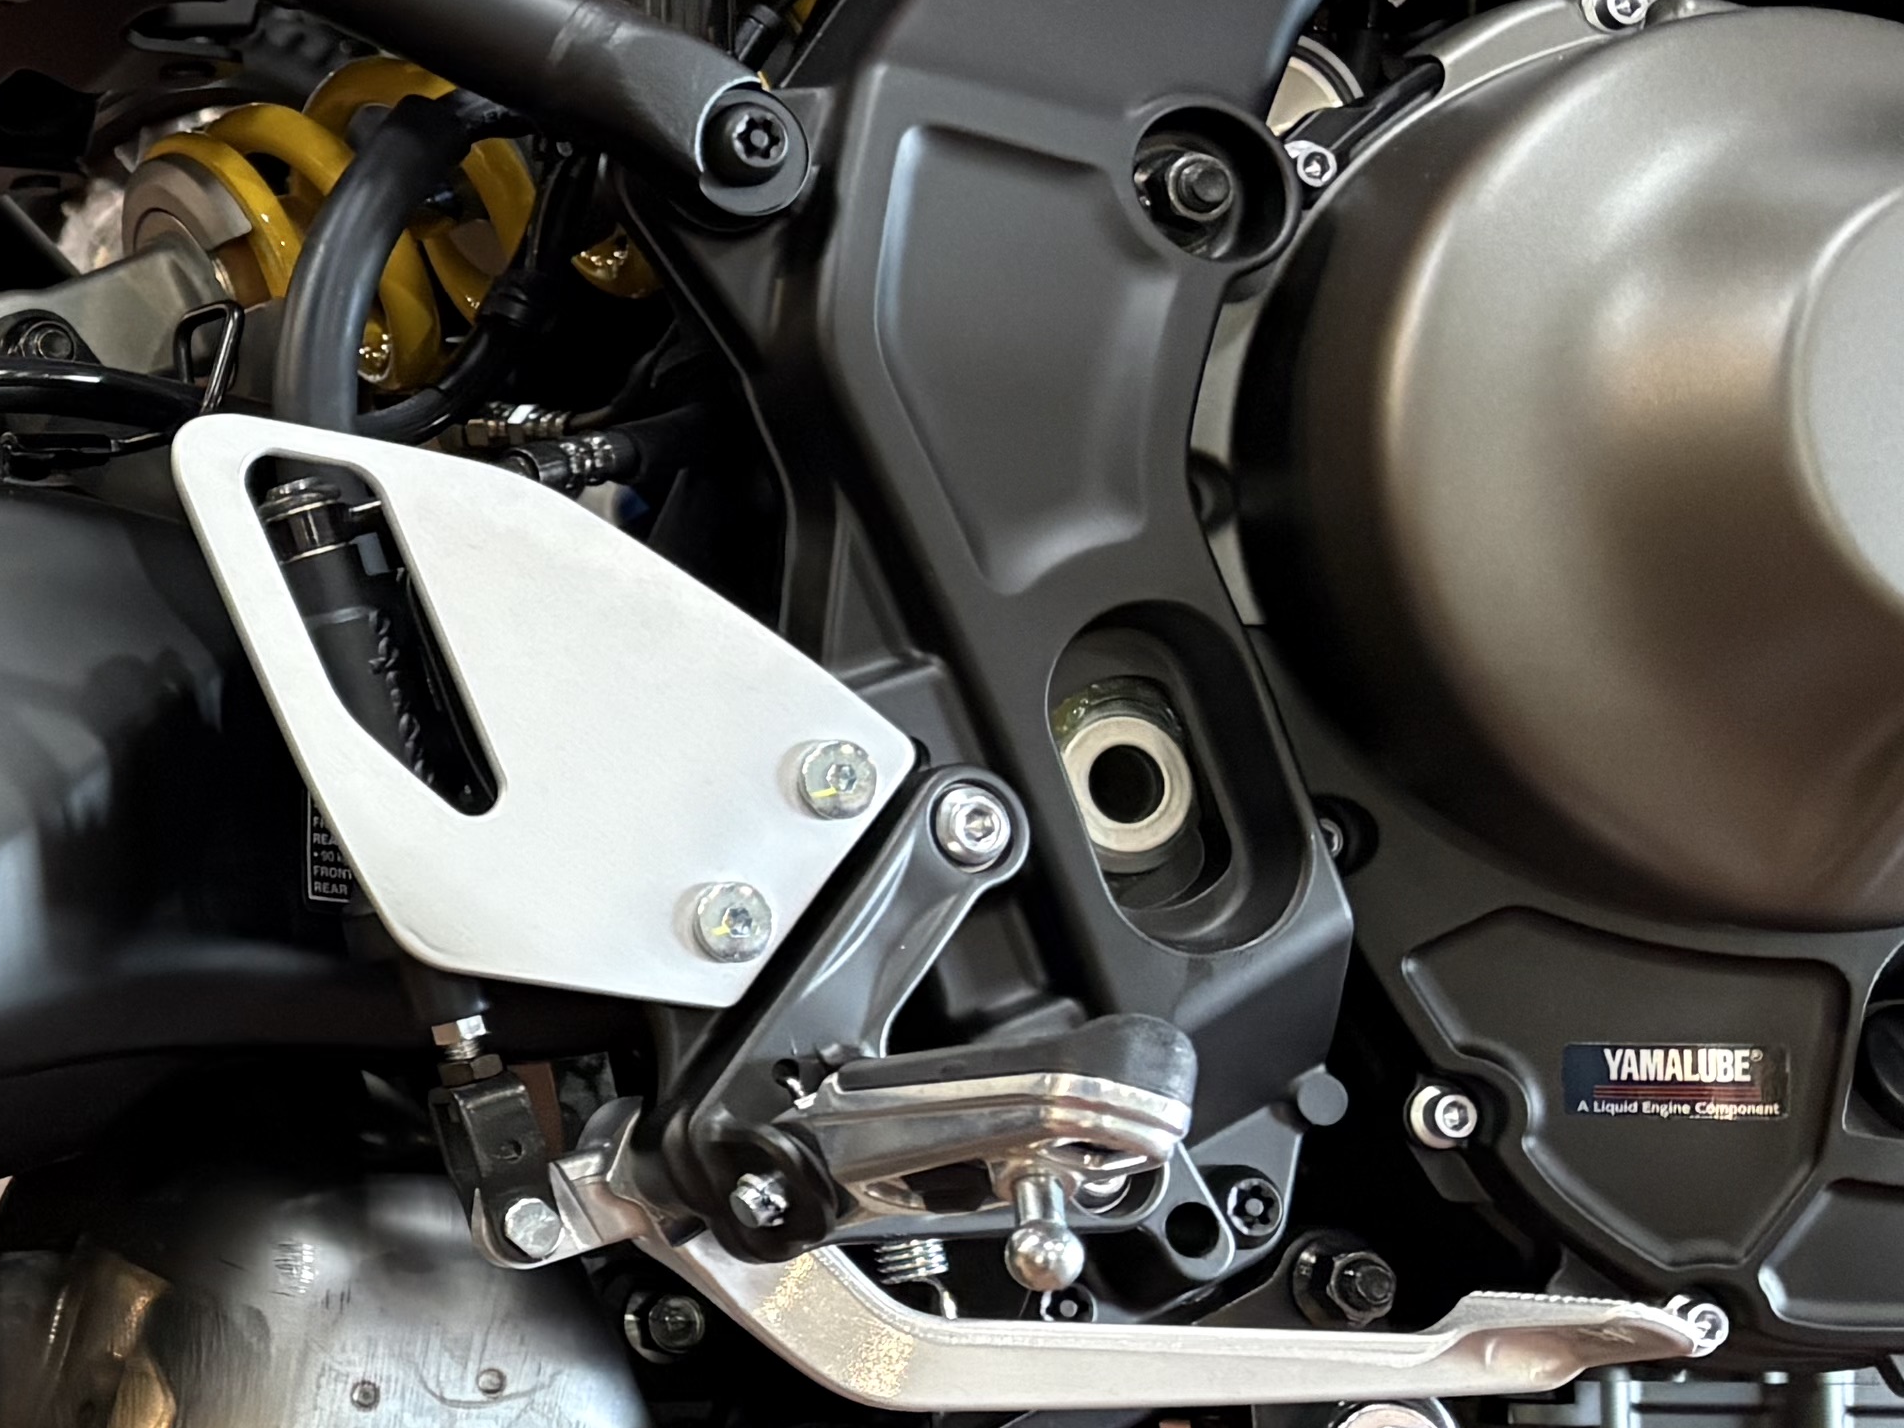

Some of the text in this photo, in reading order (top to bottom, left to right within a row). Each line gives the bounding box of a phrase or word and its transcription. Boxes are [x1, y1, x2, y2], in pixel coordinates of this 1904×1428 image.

[313, 881, 348, 895] REAR
[1576, 1099, 1780, 1121] A Liquid Engine Component
